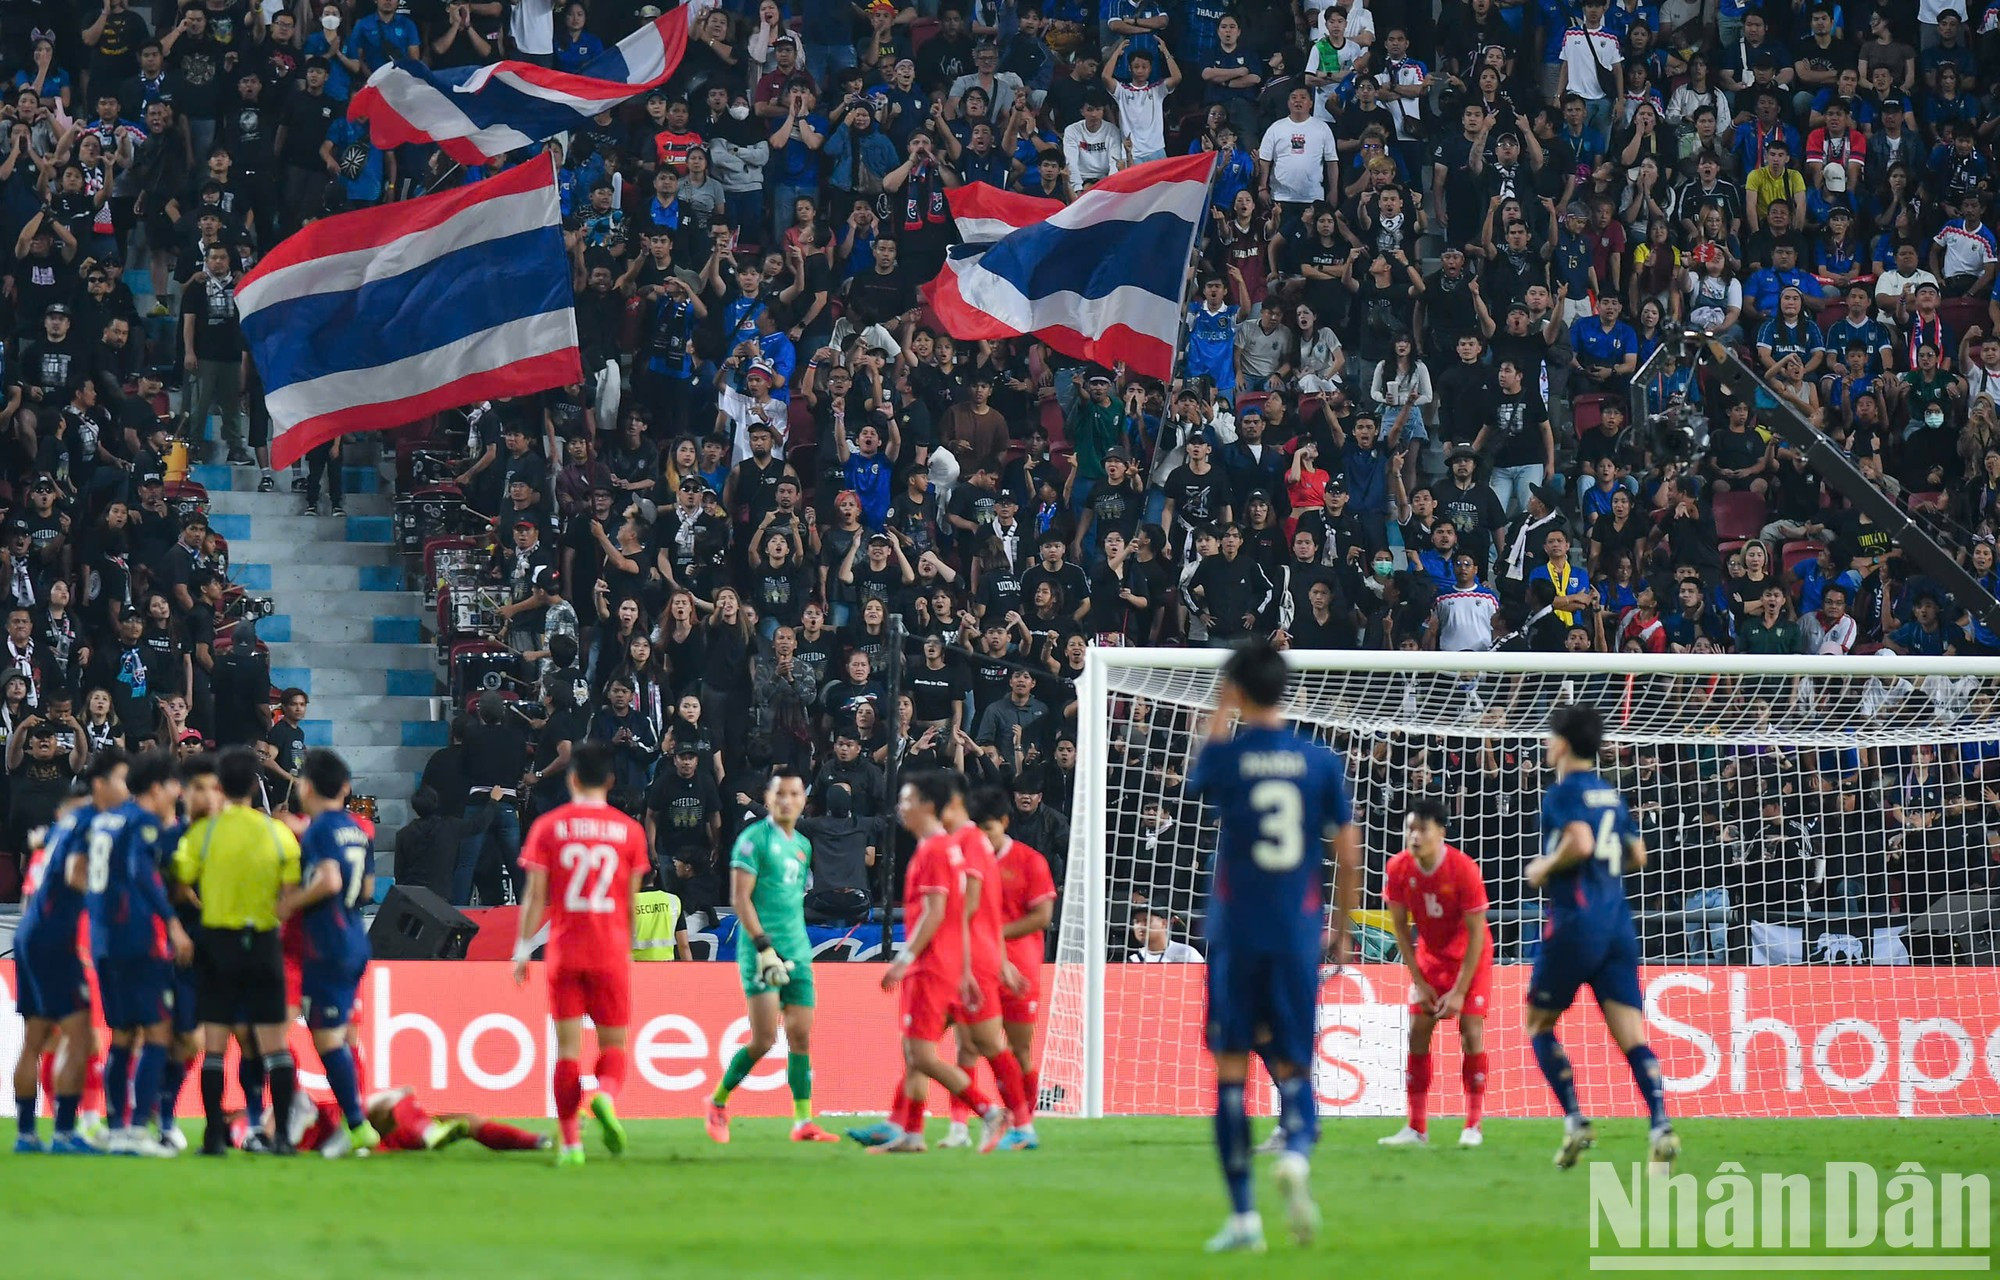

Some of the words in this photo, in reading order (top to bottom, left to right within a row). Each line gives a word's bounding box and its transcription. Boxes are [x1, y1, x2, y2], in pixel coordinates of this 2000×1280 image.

[1087, 142, 1107, 152] DIESEL
[1568, 255, 1578, 269] 15
[996, 580, 1022, 592] ULTRAS
[671, 797, 701, 808] OFFENDER
[1250, 780, 1305, 870] 3
[1595, 809, 1622, 877] 4
[89, 832, 113, 893] 8
[559, 843, 619, 913] 22
[635, 902, 670, 915] SECURITY
[1423, 892, 1444, 919] 16
[1644, 972, 2000, 1118] Shop
